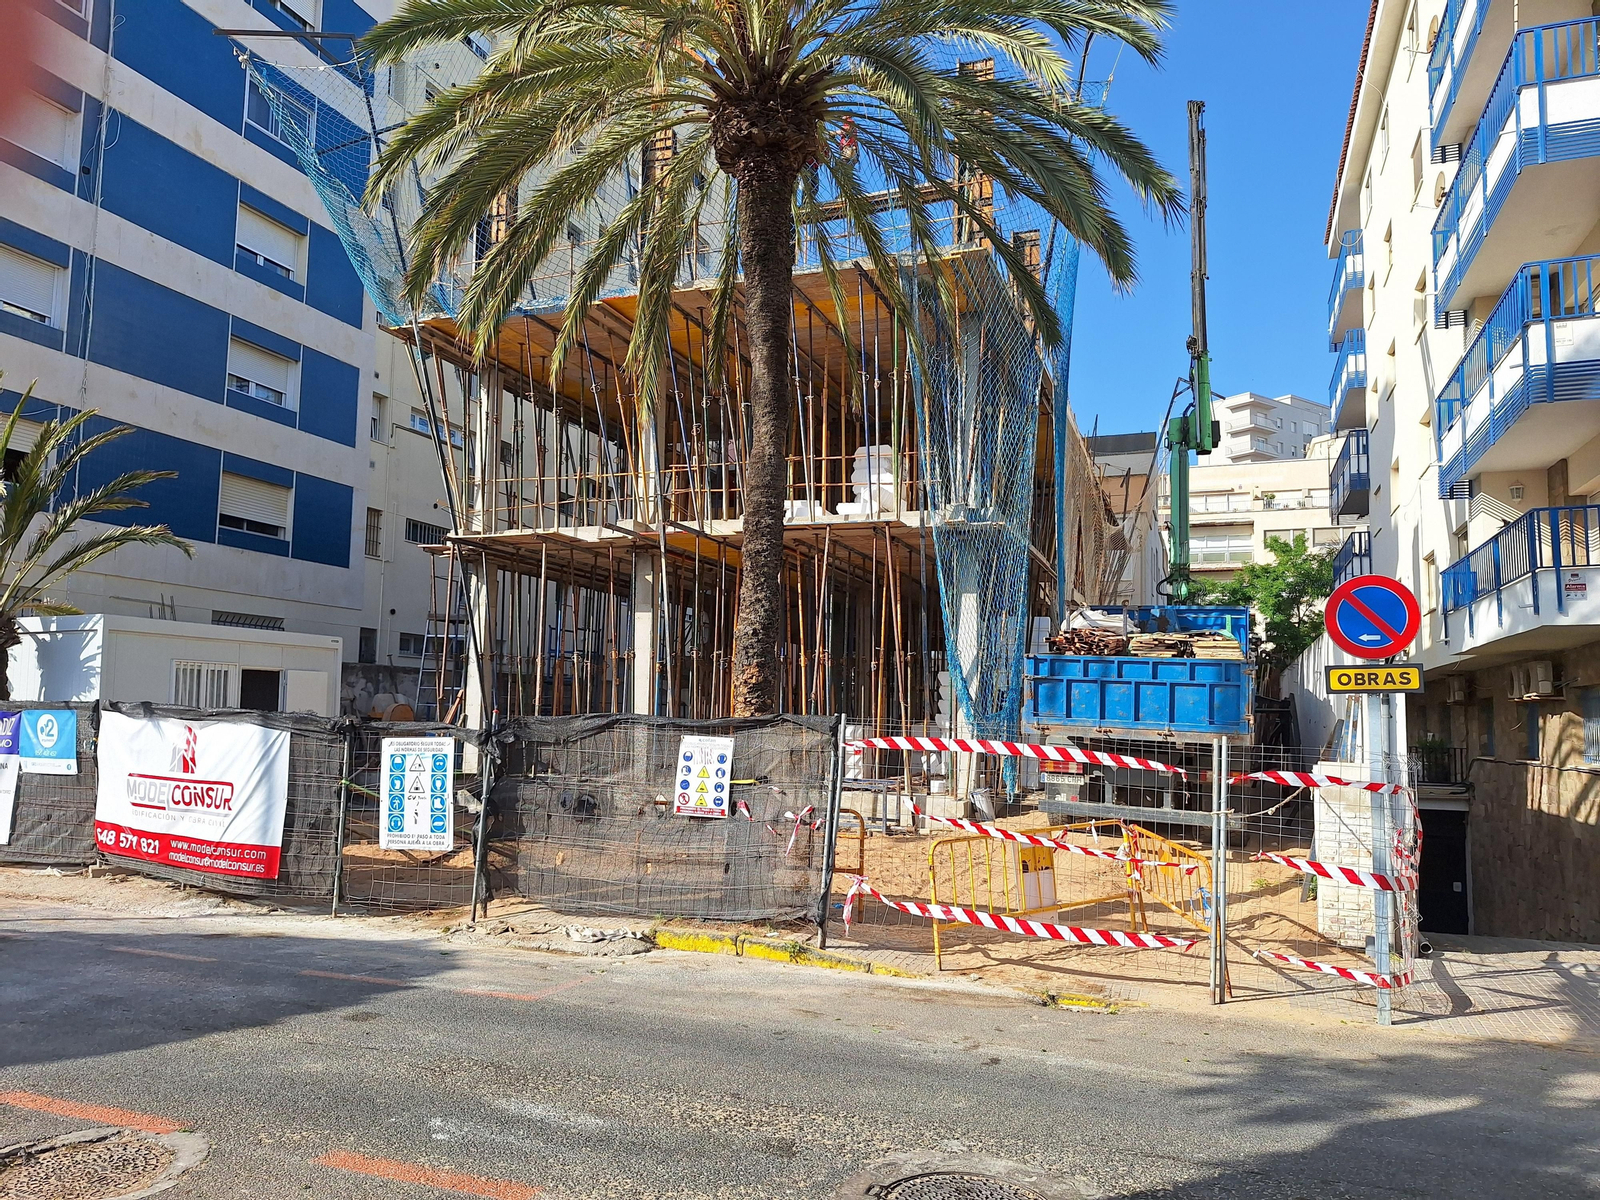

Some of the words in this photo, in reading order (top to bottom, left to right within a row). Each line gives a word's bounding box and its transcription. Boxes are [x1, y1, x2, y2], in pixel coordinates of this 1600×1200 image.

[1337, 672, 1412, 686] OBRAS
[119, 832, 138, 850] 571
[140, 837, 159, 855] 821
